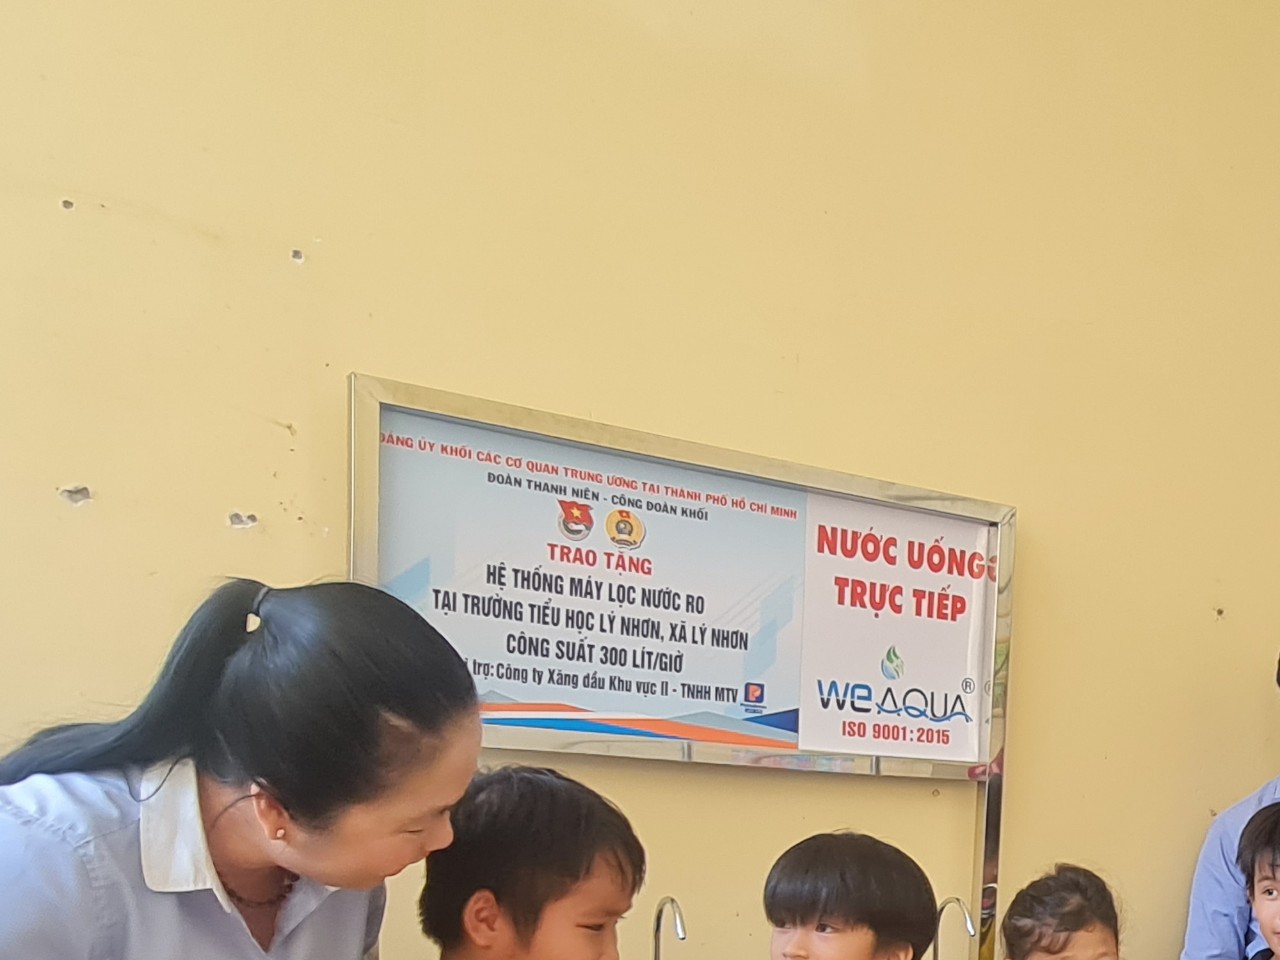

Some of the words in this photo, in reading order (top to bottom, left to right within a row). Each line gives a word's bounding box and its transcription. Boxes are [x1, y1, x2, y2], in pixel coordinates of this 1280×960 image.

[440, 443, 472, 460] KHỐI
[477, 449, 501, 465] CÁC
[505, 455, 523, 469] CƠ
[526, 459, 559, 476] QUAN
[563, 466, 604, 484] TRUNG
[607, 474, 638, 490] ƯƠNG
[641, 481, 660, 496] TẠI
[705, 492, 728, 507] PHỐ
[750, 501, 767, 513] CHÍ
[770, 505, 797, 519] MINH
[487, 471, 522, 488] ĐOÀN
[526, 479, 567, 496] THANH
[571, 486, 600, 502] NIÊN
[611, 493, 643, 510] CÔNG
[646, 500, 678, 516] ĐOÀN
[681, 506, 709, 521] KHỐI
[547, 543, 597, 567] TRAO
[603, 550, 652, 576] TẶNG
[817, 526, 898, 566] NƯỚC
[907, 536, 986, 580] UỐNG
[486, 562, 507, 590] HỆ
[512, 565, 564, 595] THỐNG
[569, 575, 603, 600] MÁY
[608, 583, 636, 608] LỌC
[641, 587, 681, 611] NƯỚC
[685, 594, 705, 614] RO
[834, 576, 903, 618] TRỰC
[912, 584, 967, 621] TIẾP
[432, 588, 457, 615] TẠI
[462, 593, 523, 622] TRƯỜNG
[528, 598, 561, 627] TIỂU
[565, 608, 595, 634] HỌC
[600, 611, 616, 634] LÝ
[620, 615, 665, 643] NHƠN,
[669, 620, 687, 643] XÃ
[692, 623, 707, 645] LÝ
[711, 628, 748, 650] NHƠN
[506, 631, 550, 658] CÔNG
[555, 636, 596, 663] SUẤT
[600, 645, 628, 667] 300
[632, 646, 684, 673] LÍT/GIỜ
[496, 663, 528, 684] Công
[532, 667, 544, 686] ty
[547, 668, 579, 689] Xăng
[609, 675, 632, 692] Khu
[636, 681, 657, 698] vực
[681, 683, 711, 701] TNHH
[715, 687, 738, 703] MTV
[842, 720, 867, 738] ISO
